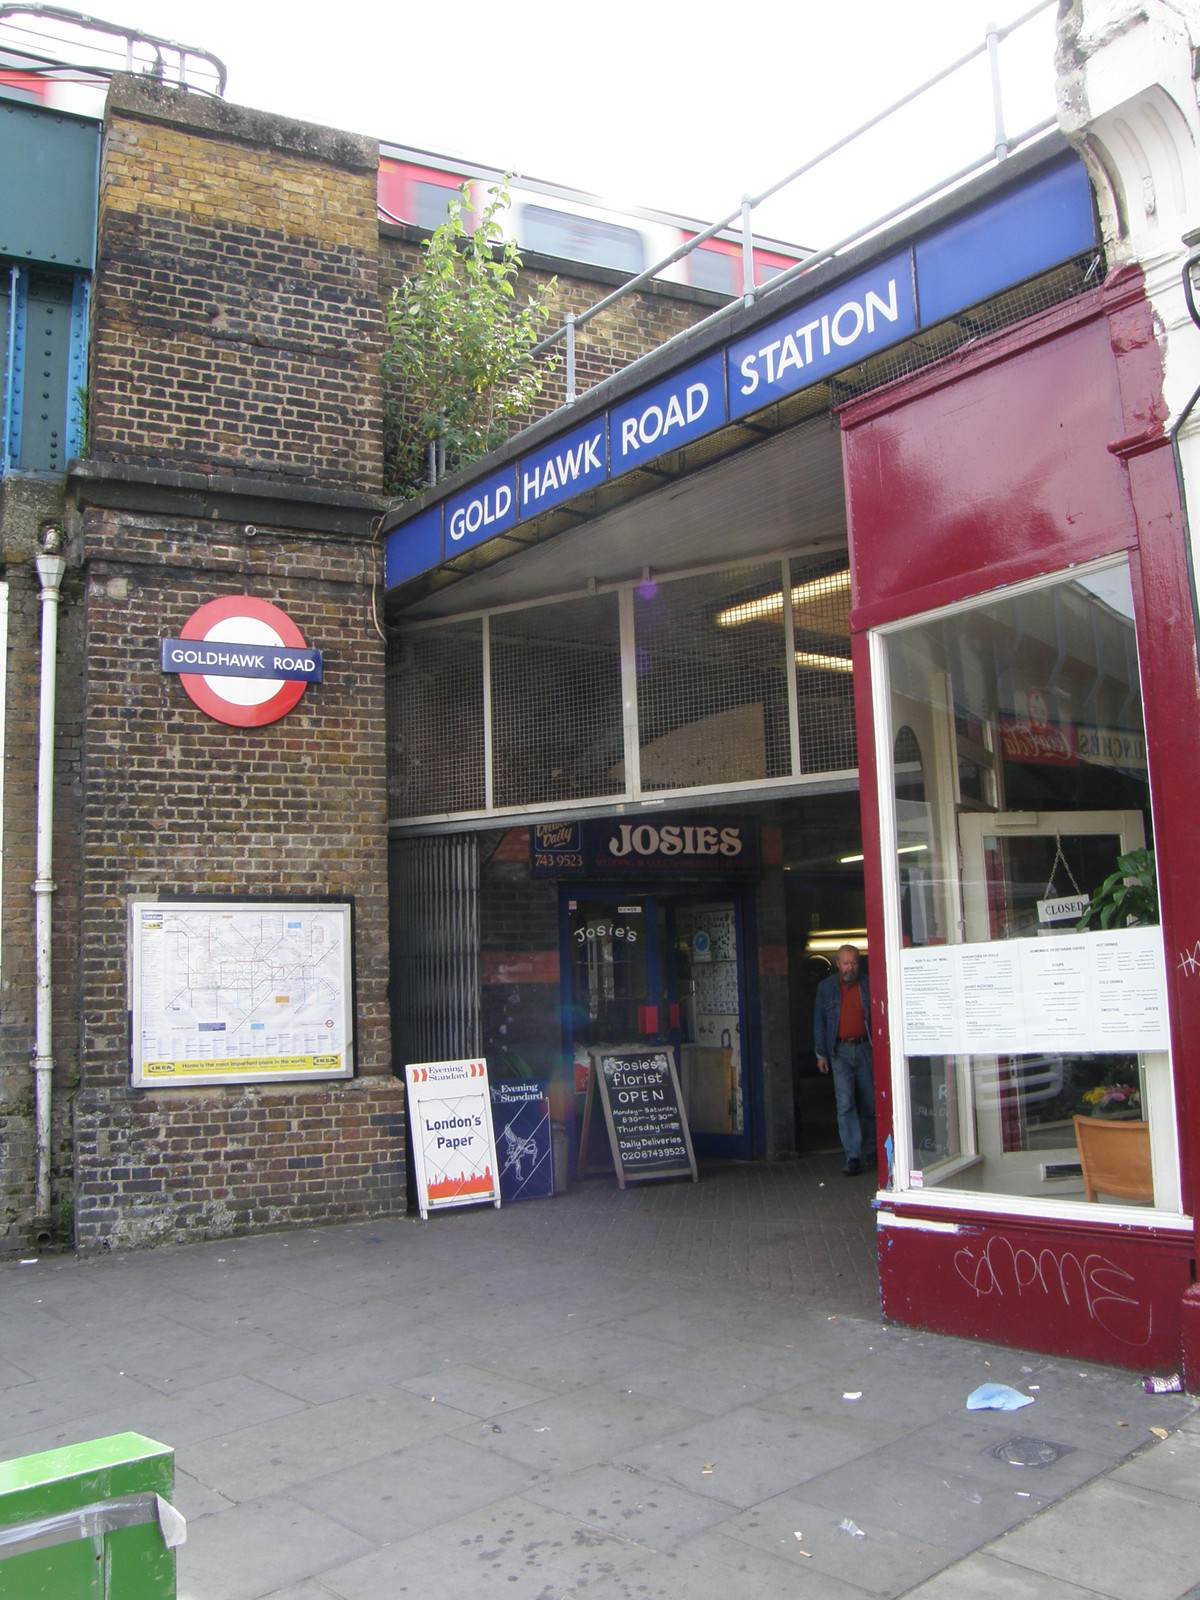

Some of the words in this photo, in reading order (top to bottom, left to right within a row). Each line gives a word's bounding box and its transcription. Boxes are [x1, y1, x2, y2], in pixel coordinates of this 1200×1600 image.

[449, 484, 512, 541] GOLD
[522, 433, 603, 505] HAWK
[621, 382, 710, 456] ROAD
[740, 278, 899, 396] STATION
[171, 649, 265, 669] GOLDHAWK
[273, 657, 316, 672] ROAD
[543, 827, 573, 848] Daily
[608, 824, 743, 858] JOSIES
[535, 853, 555, 867] 743
[556, 853, 583, 867] 9523
[1044, 901, 1084, 916] CLOSED
[573, 924, 638, 943] Josie's
[151, 1064, 173, 1072] IKEA
[428, 1065, 464, 1075] Evening
[614, 1059, 658, 1072] Josie's
[428, 1072, 469, 1082] Standard
[612, 1072, 663, 1086] florist
[501, 1083, 539, 1093] Evening
[501, 1091, 543, 1103] Standard
[618, 1089, 665, 1103] OPEN
[425, 1114, 482, 1131] London's
[616, 1123, 661, 1134] Thursday
[437, 1136, 474, 1150] Paper
[619, 1138, 641, 1150] Daily
[640, 1136, 682, 1147] Deliveries
